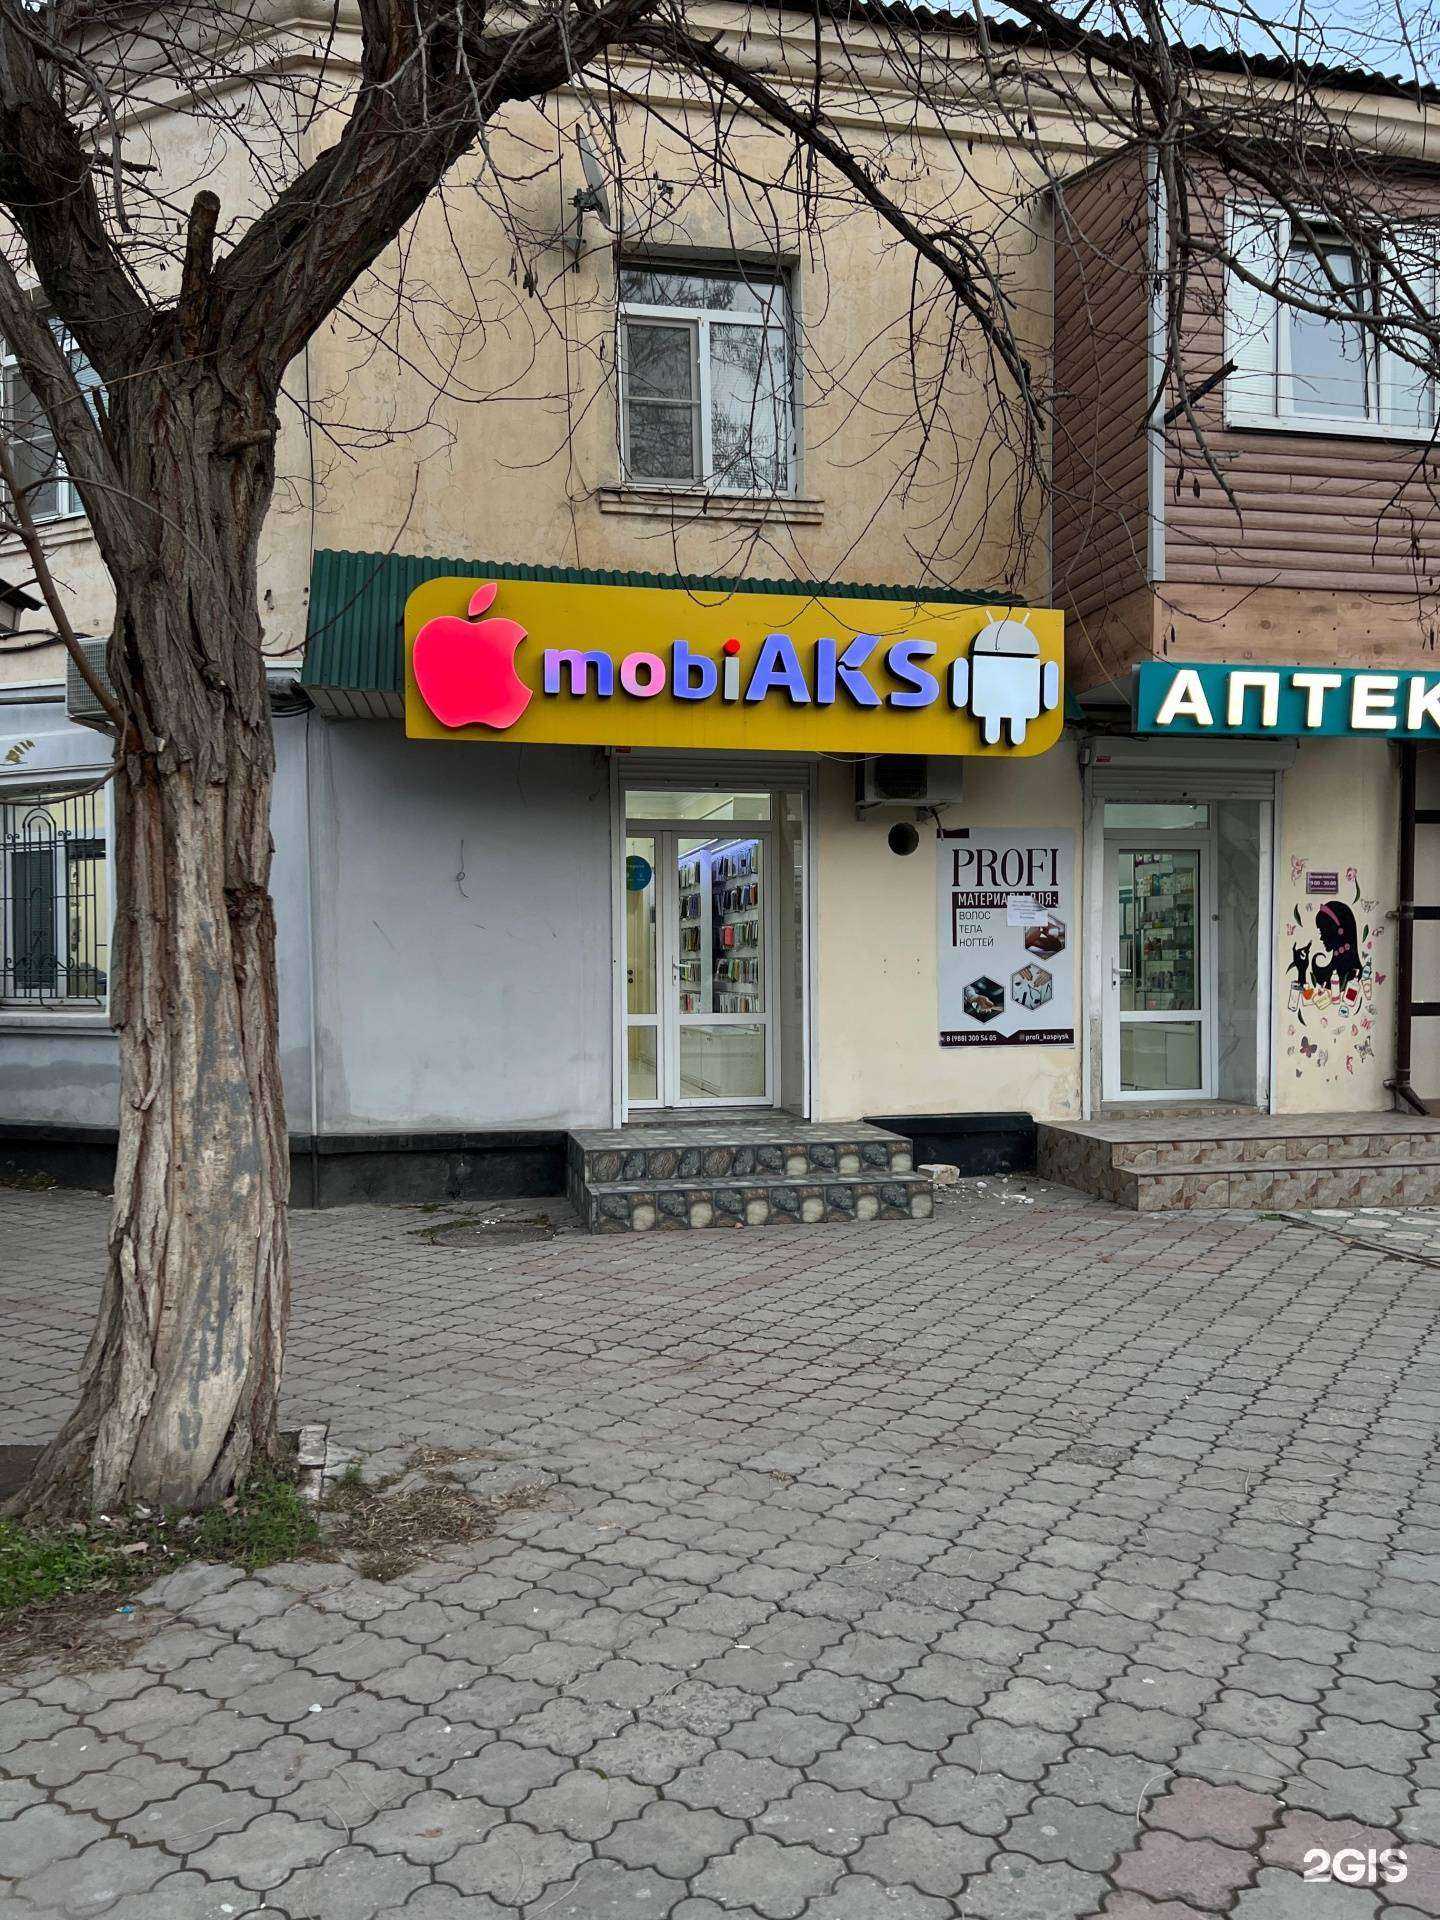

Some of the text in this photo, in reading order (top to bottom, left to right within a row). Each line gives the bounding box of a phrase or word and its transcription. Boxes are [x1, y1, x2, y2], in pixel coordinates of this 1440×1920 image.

[543, 633, 940, 708] mobiAKS
[1156, 669, 1440, 730] АПТЕК
[951, 848, 1059, 887] PROFI
[958, 892, 1026, 906] МАТЕРИА
[959, 911, 991, 920] ВОЛОС
[959, 925, 983, 934] ТЕЛА
[959, 936, 994, 947] НОГТЕЙ
